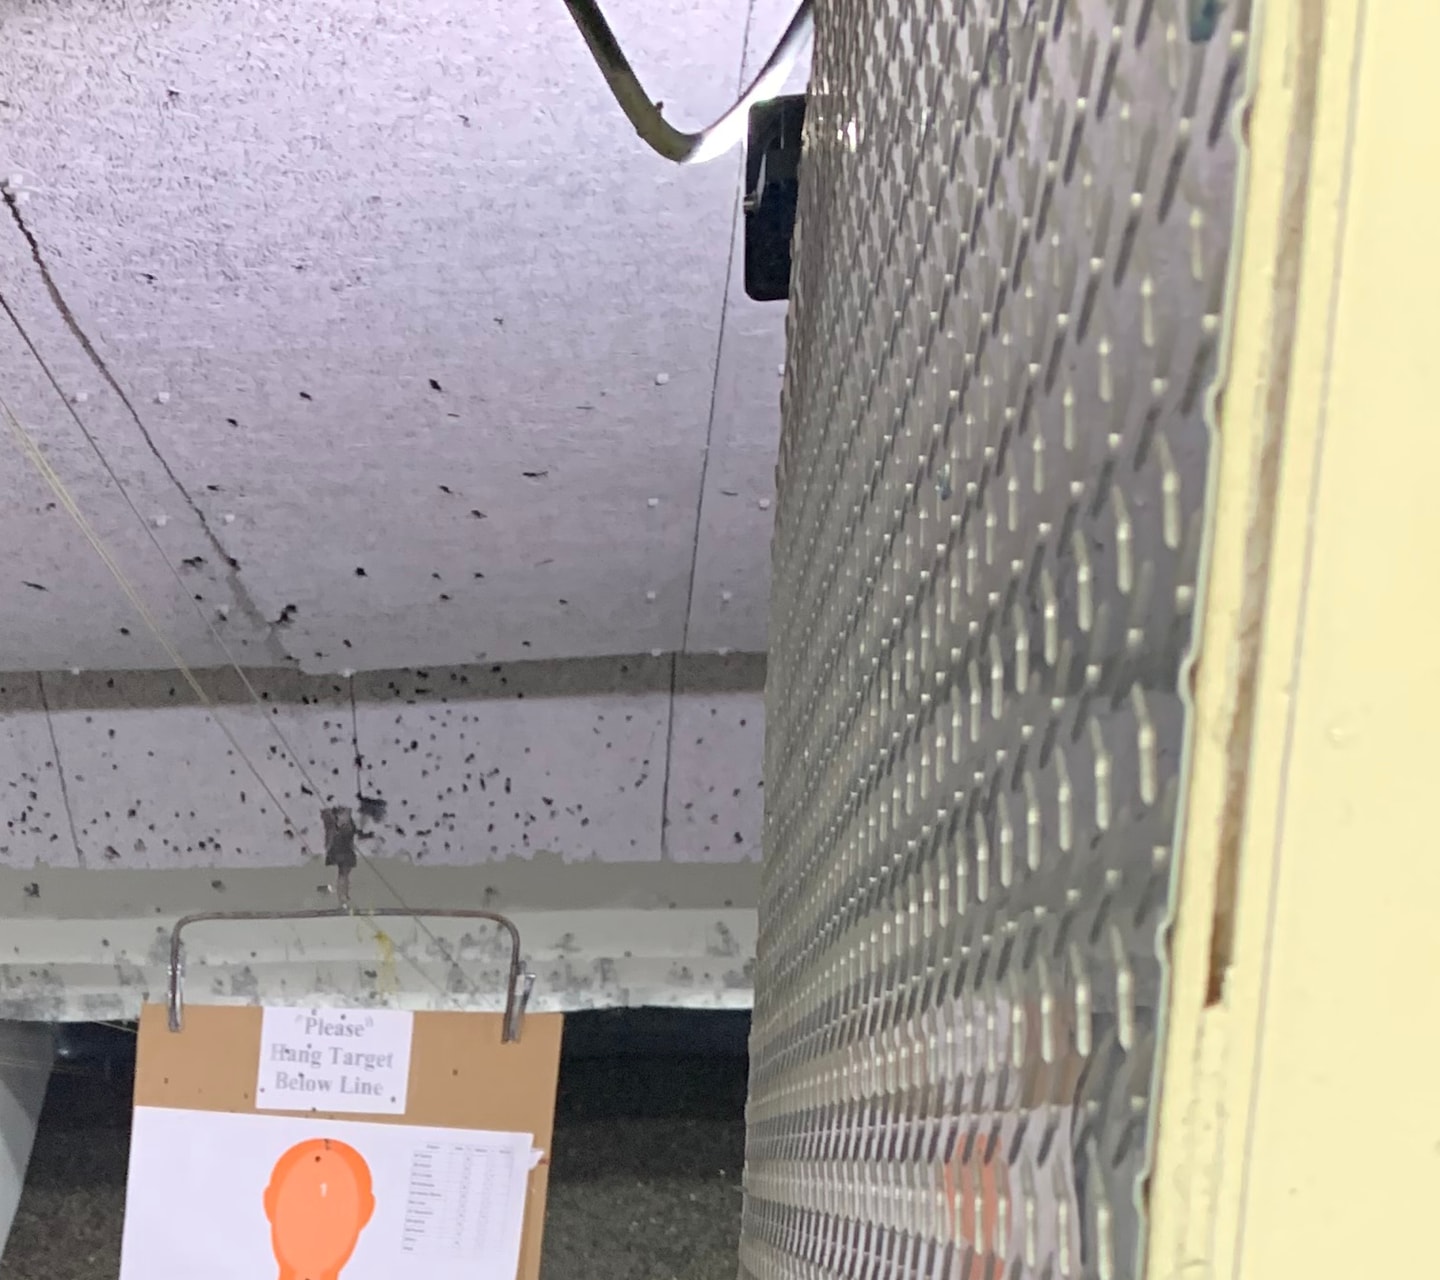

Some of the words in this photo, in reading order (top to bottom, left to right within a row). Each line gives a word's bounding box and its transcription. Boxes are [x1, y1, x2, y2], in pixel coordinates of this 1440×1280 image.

[270, 1043, 322, 1069] Hang
[328, 1047, 394, 1073] Target
[276, 1072, 333, 1092] Below
[340, 1076, 384, 1096] Line
